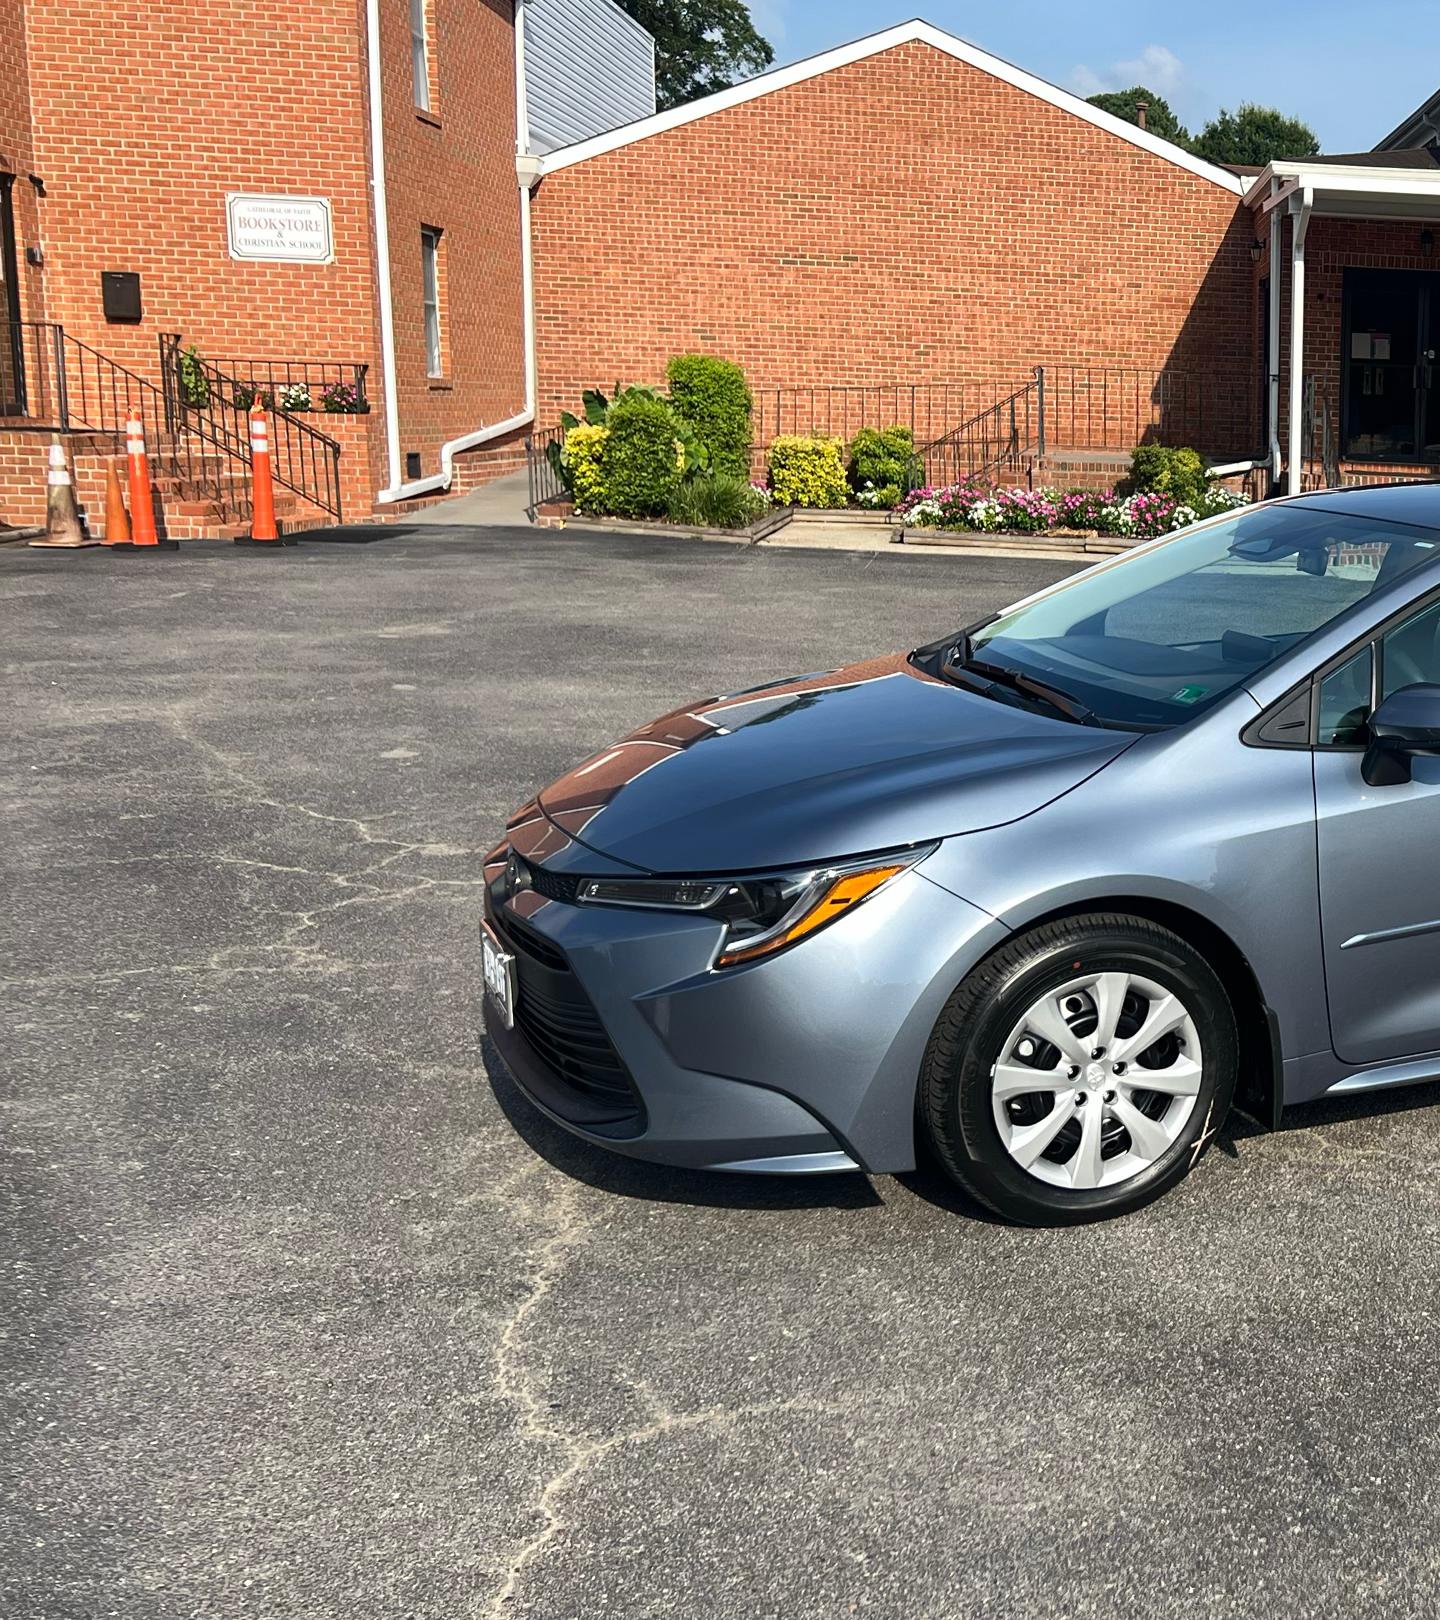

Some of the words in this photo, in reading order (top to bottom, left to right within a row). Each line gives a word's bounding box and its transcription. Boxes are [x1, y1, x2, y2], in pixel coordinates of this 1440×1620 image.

[238, 216, 322, 233] BOOKSTORE
[238, 238, 286, 249] CHRISTIAN
[289, 241, 322, 250] SCHOOL
